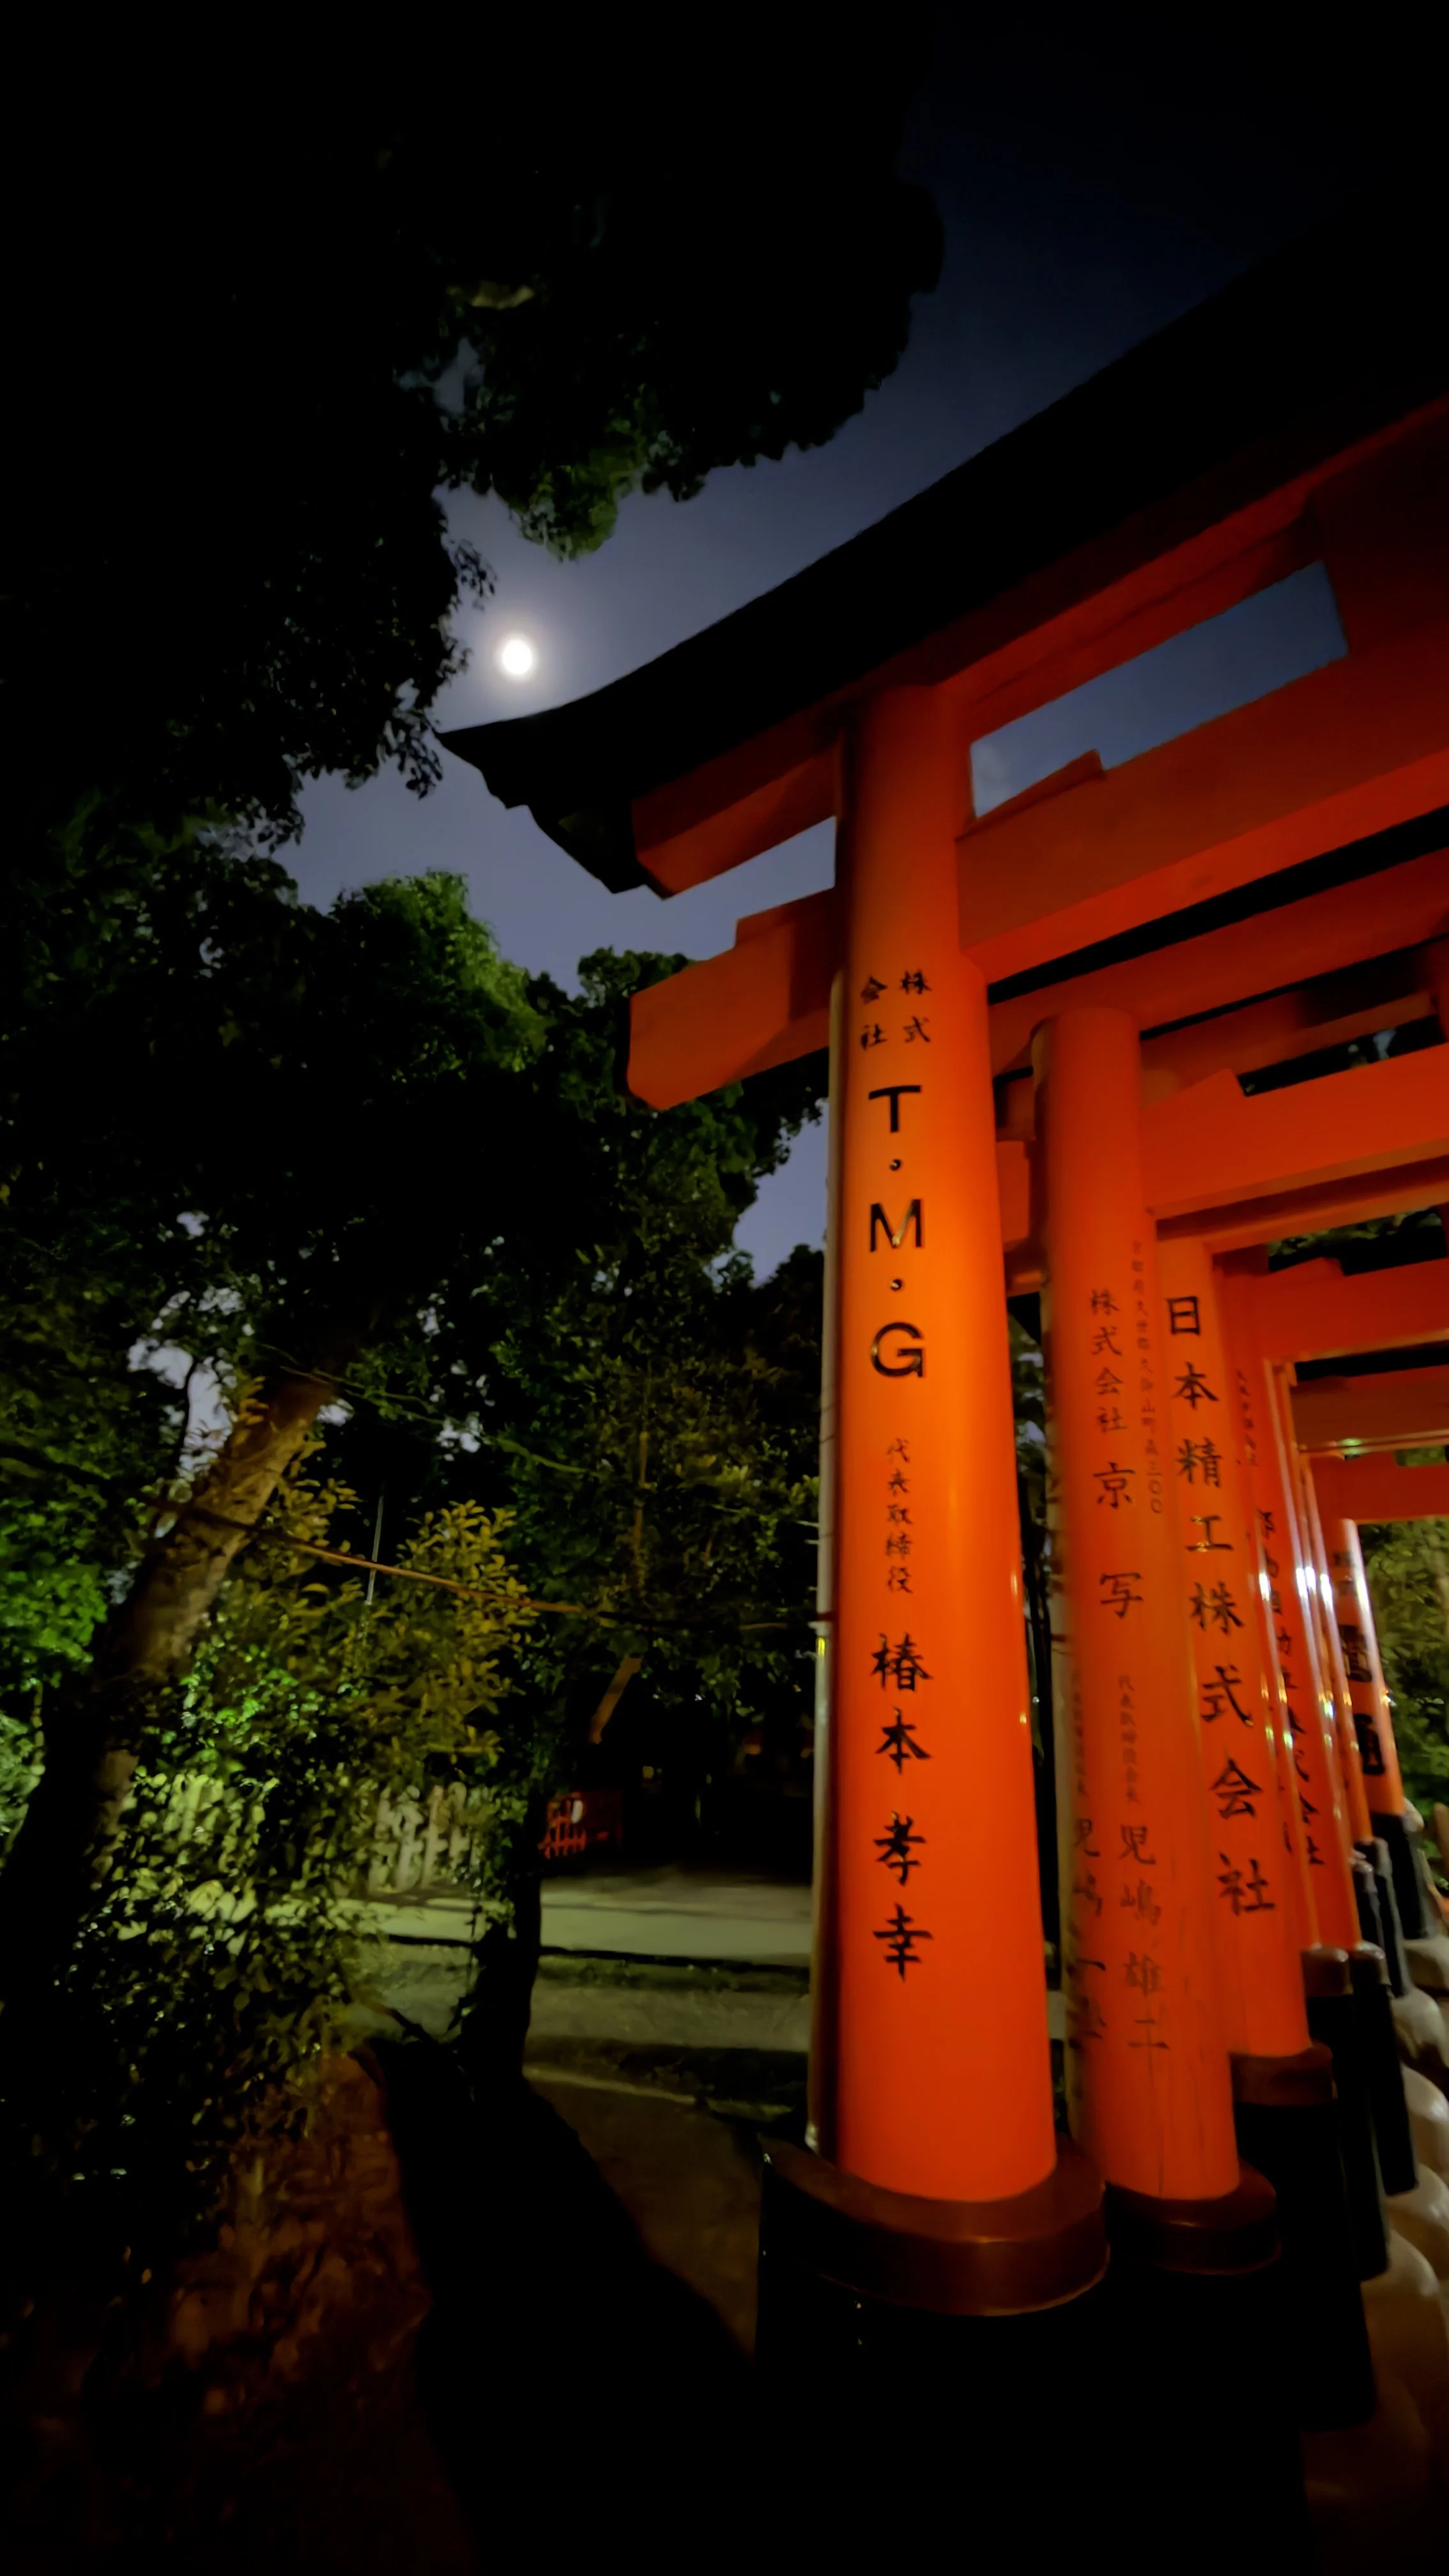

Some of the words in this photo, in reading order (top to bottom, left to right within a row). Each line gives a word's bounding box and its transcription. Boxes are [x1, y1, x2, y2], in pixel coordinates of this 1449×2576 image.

[860, 975, 887, 1050] 会社
[900, 969, 932, 1043] 株式
[886, 1437, 914, 1595] 代表取締役
[1165, 1296, 1275, 1916] 日本精工株式会社
